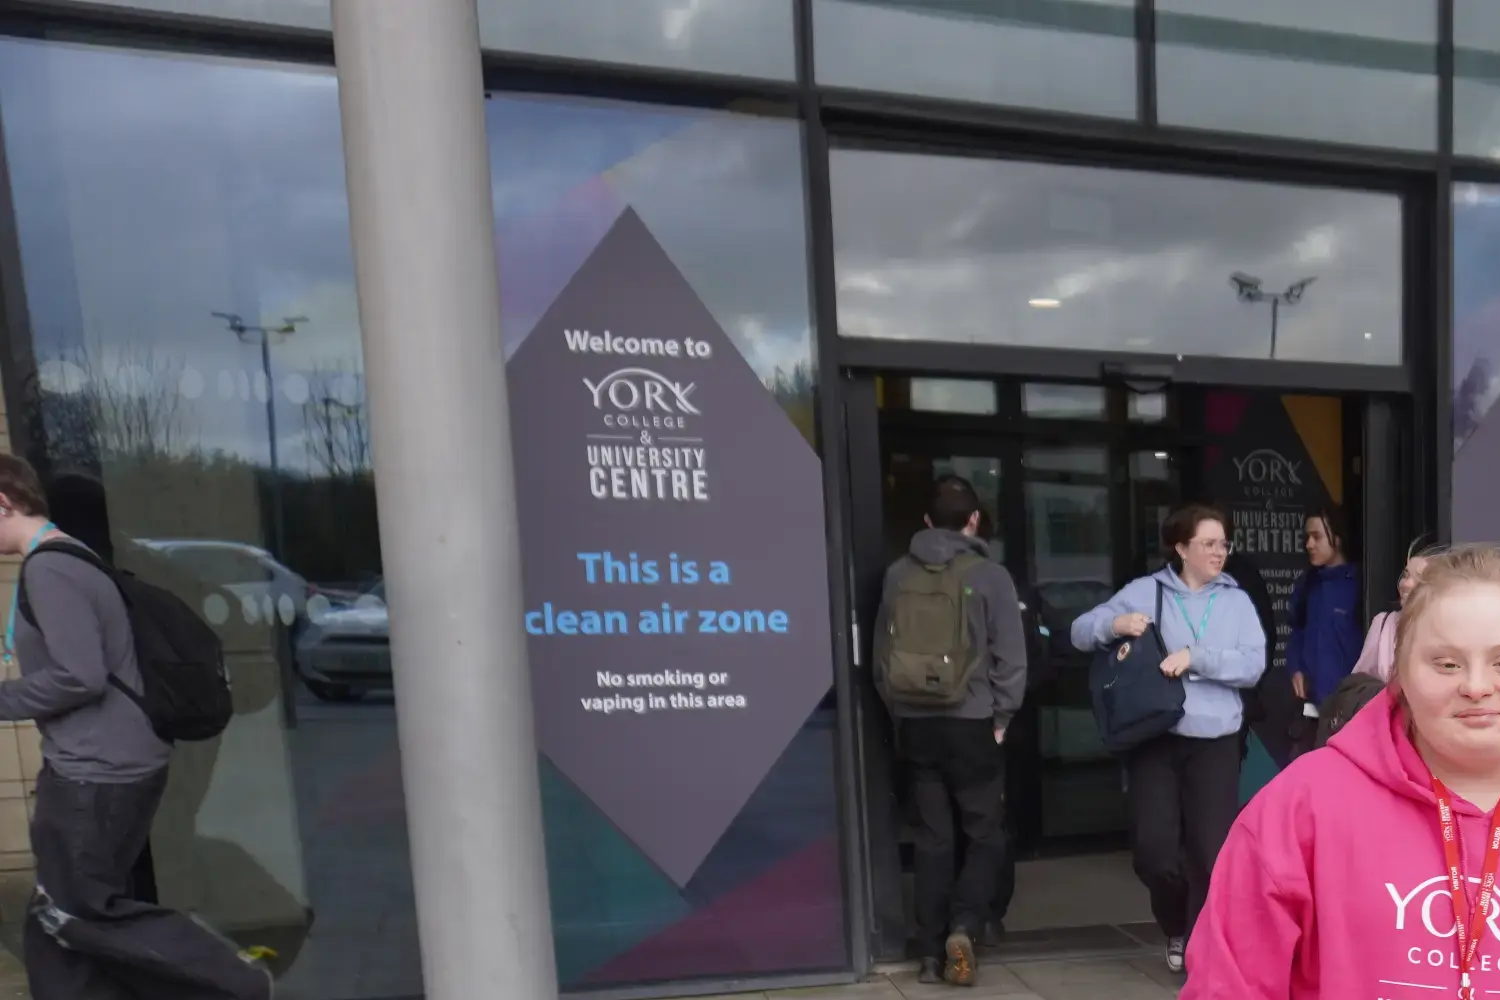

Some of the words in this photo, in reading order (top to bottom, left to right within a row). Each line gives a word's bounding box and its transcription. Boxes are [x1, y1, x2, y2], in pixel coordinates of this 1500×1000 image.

[564, 329, 680, 355] Welcome
[684, 337, 711, 357] to
[582, 367, 701, 416] YORK
[603, 414, 685, 428] COLLEGE
[640, 430, 651, 445] &
[586, 445, 706, 468] UNIVERSITY
[1233, 448, 1302, 485] YORK
[589, 467, 708, 499] CENTRE
[1233, 510, 1305, 528] UNIVERSITY
[1233, 528, 1305, 553] CENTRE
[577, 551, 660, 584] This
[669, 552, 700, 584] is
[708, 560, 730, 584] a
[525, 602, 629, 636] clean
[638, 602, 688, 634] air
[698, 608, 789, 634] zone
[596, 670, 623, 687] No
[627, 669, 704, 688] smoking
[708, 672, 728, 686] or
[581, 693, 645, 713] vaping
[649, 693, 666, 709] in
[669, 692, 703, 709] this
[707, 694, 746, 708] area
[1450, 866, 1459, 891] VISITOR
[1467, 938, 1478, 962] VISITOR
